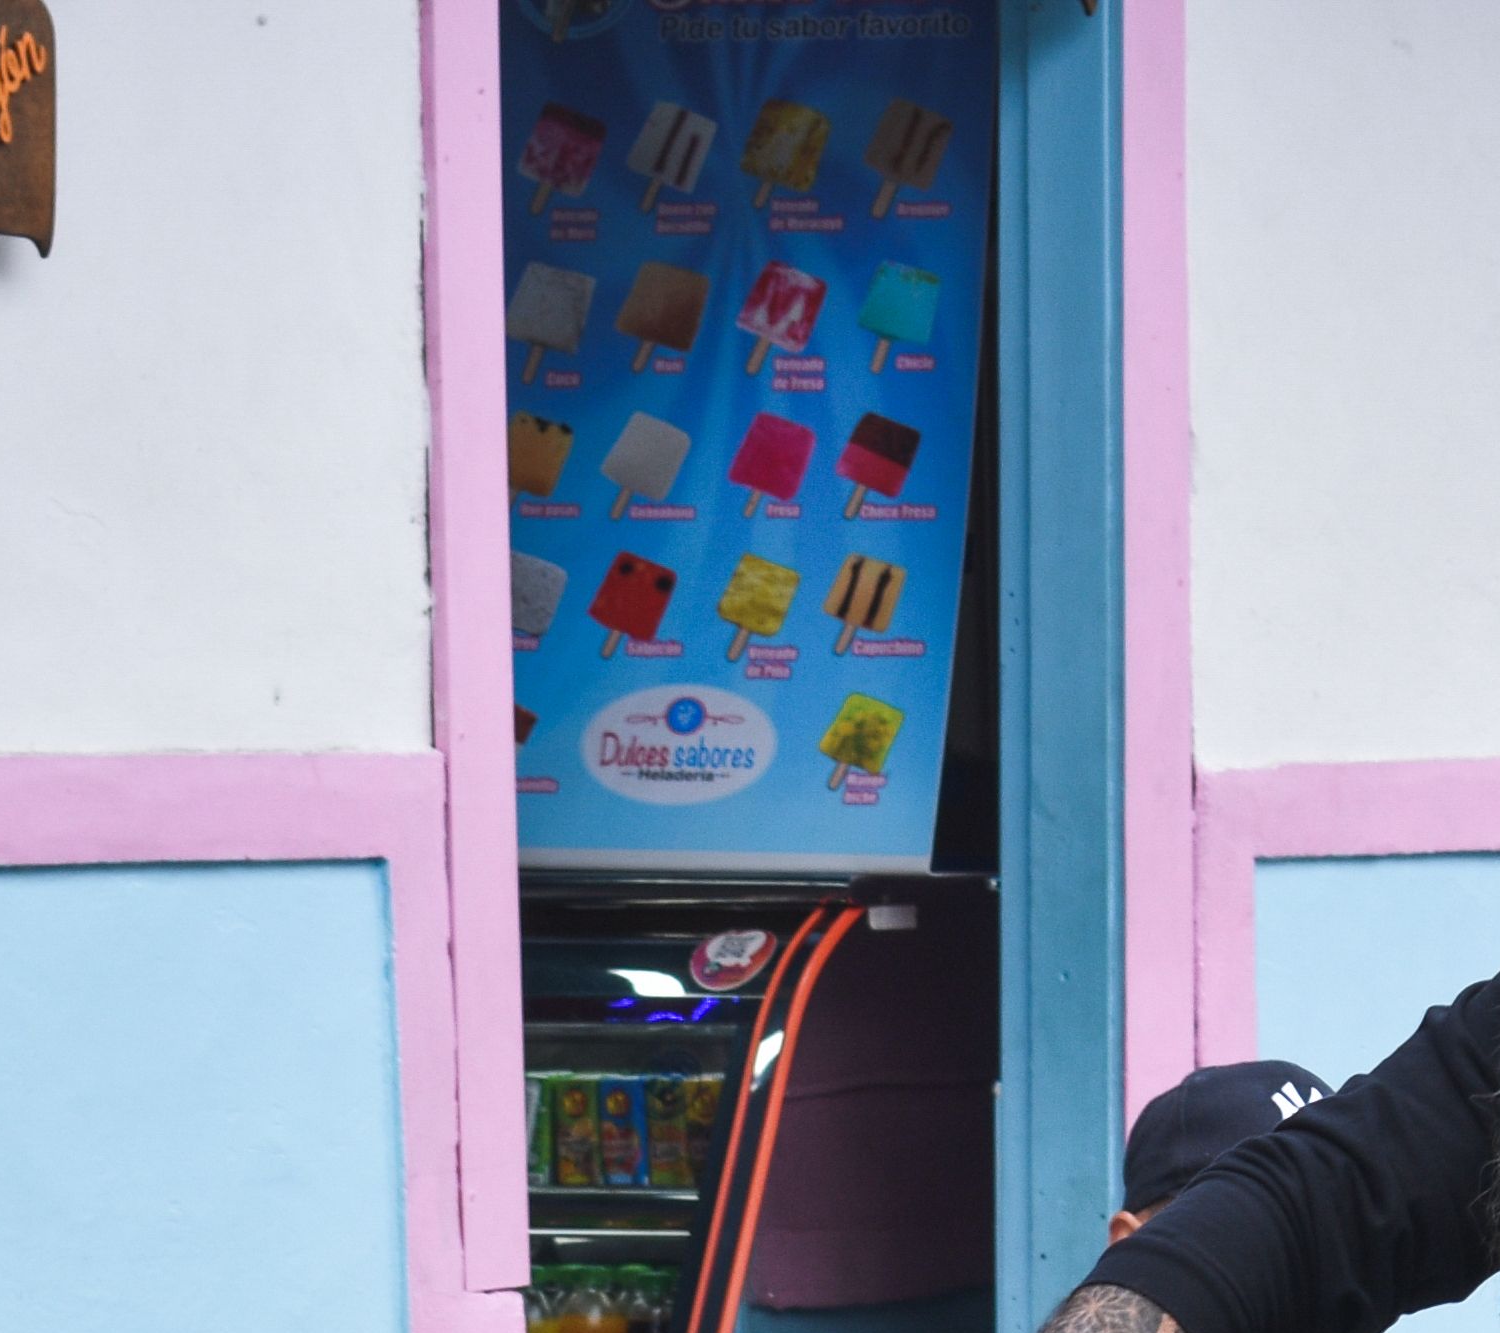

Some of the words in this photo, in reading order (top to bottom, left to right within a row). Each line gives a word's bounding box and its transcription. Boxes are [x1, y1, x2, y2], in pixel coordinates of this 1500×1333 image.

[659, 13, 724, 41] Pide
[731, 13, 759, 40] tu
[766, 12, 849, 39] sabor
[859, 10, 970, 38] favorito
[599, 731, 669, 767] Dulces
[674, 736, 755, 769] sabores
